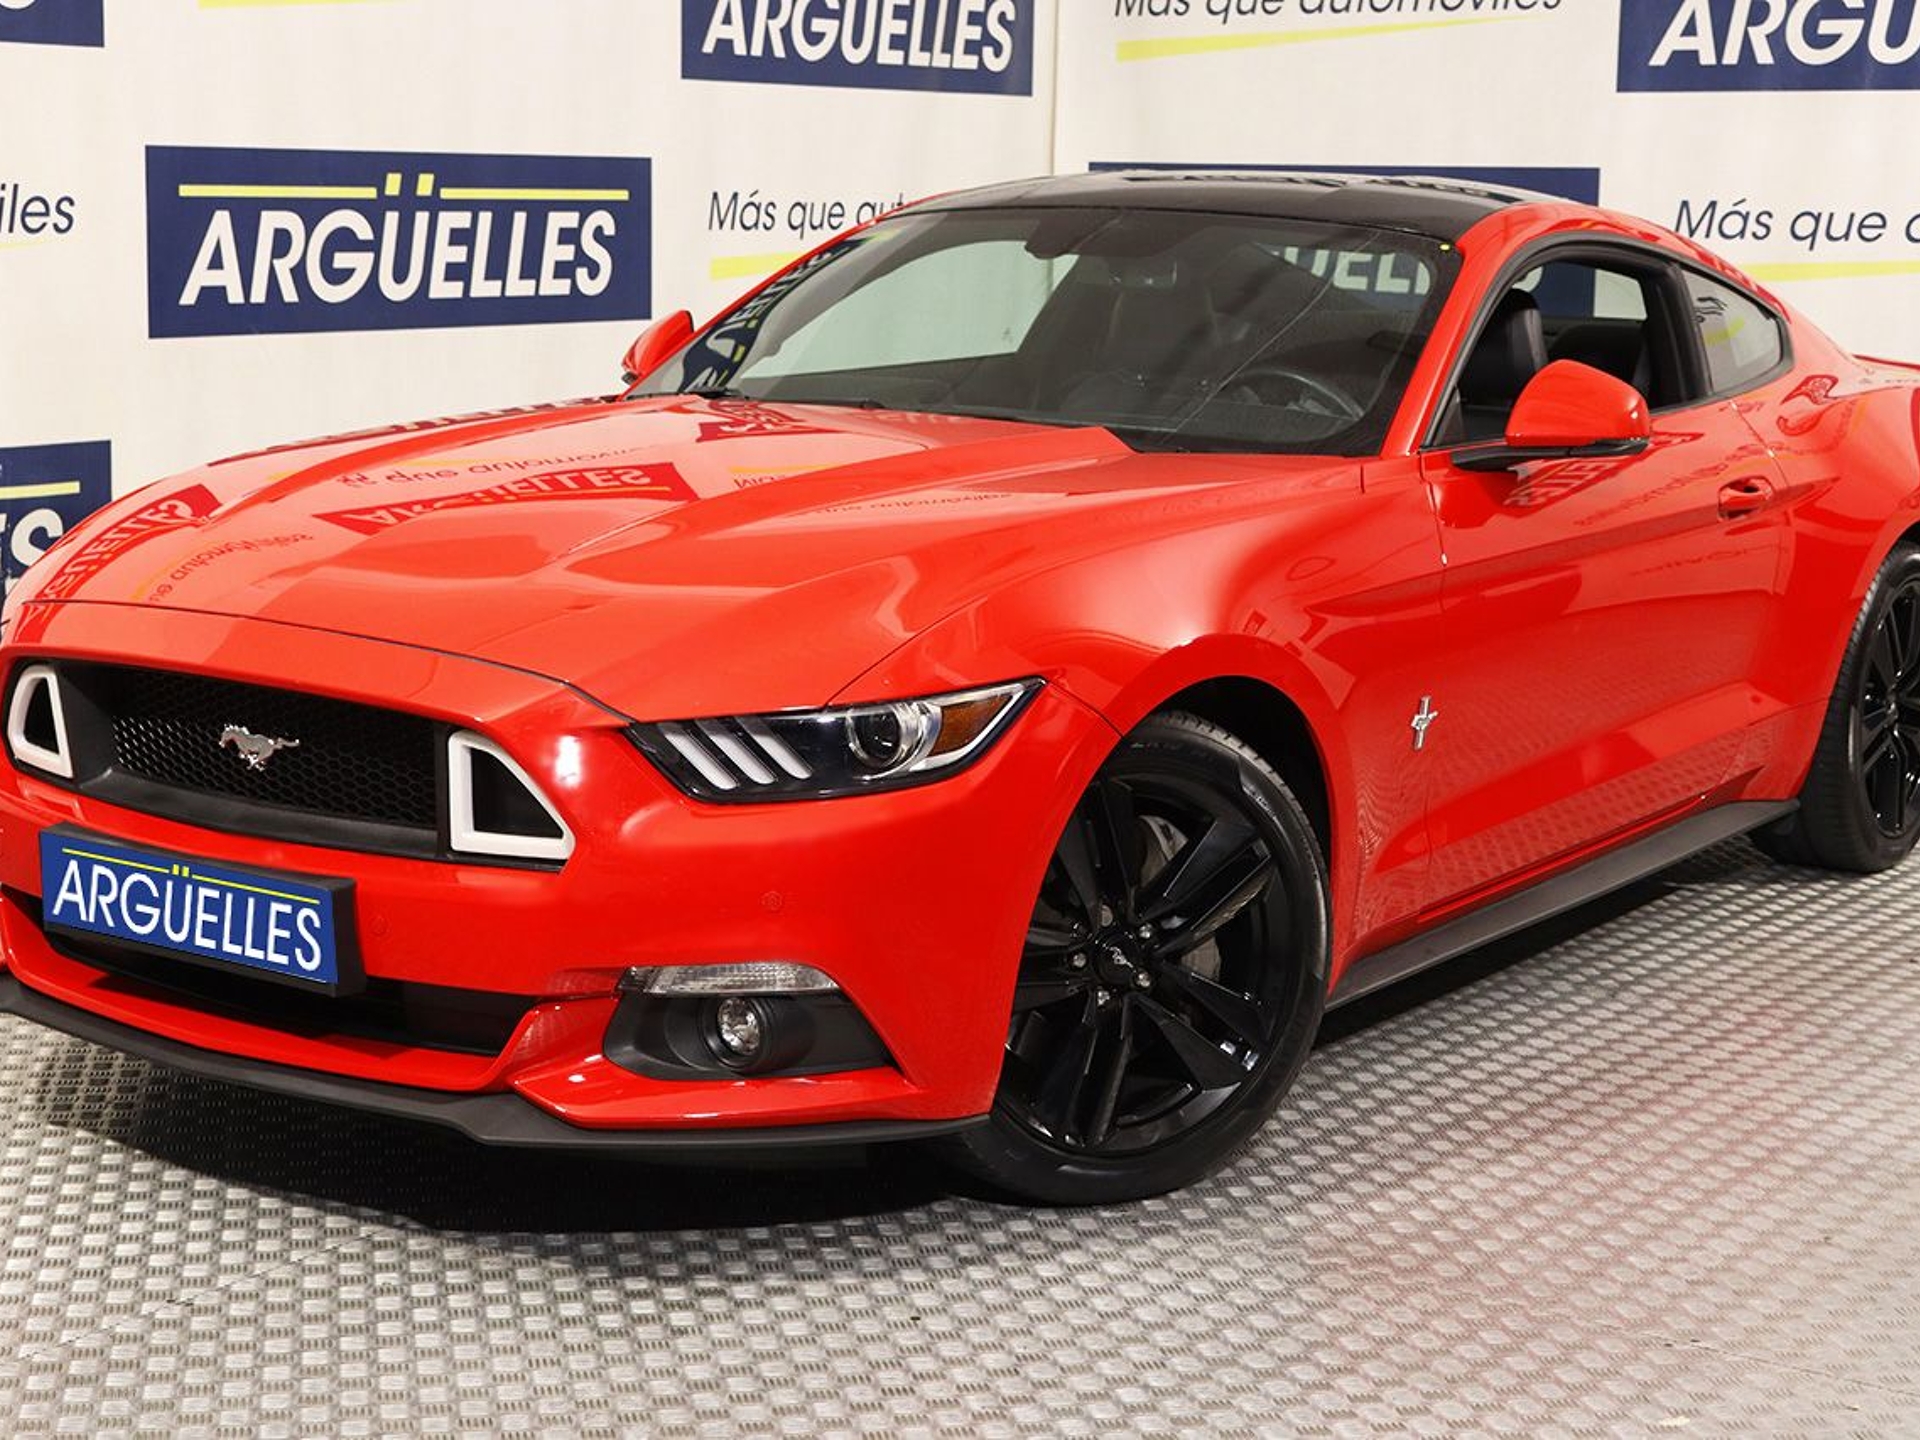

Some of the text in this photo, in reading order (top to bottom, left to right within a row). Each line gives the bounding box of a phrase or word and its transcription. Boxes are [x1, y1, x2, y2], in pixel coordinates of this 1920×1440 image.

[178, 172, 618, 305] ARGÜELLES
[708, 189, 776, 231] Más
[787, 201, 846, 240] que
[1675, 198, 1773, 240] Más
[1790, 210, 1887, 251] que
[52, 863, 322, 972] ARGÜELLES
